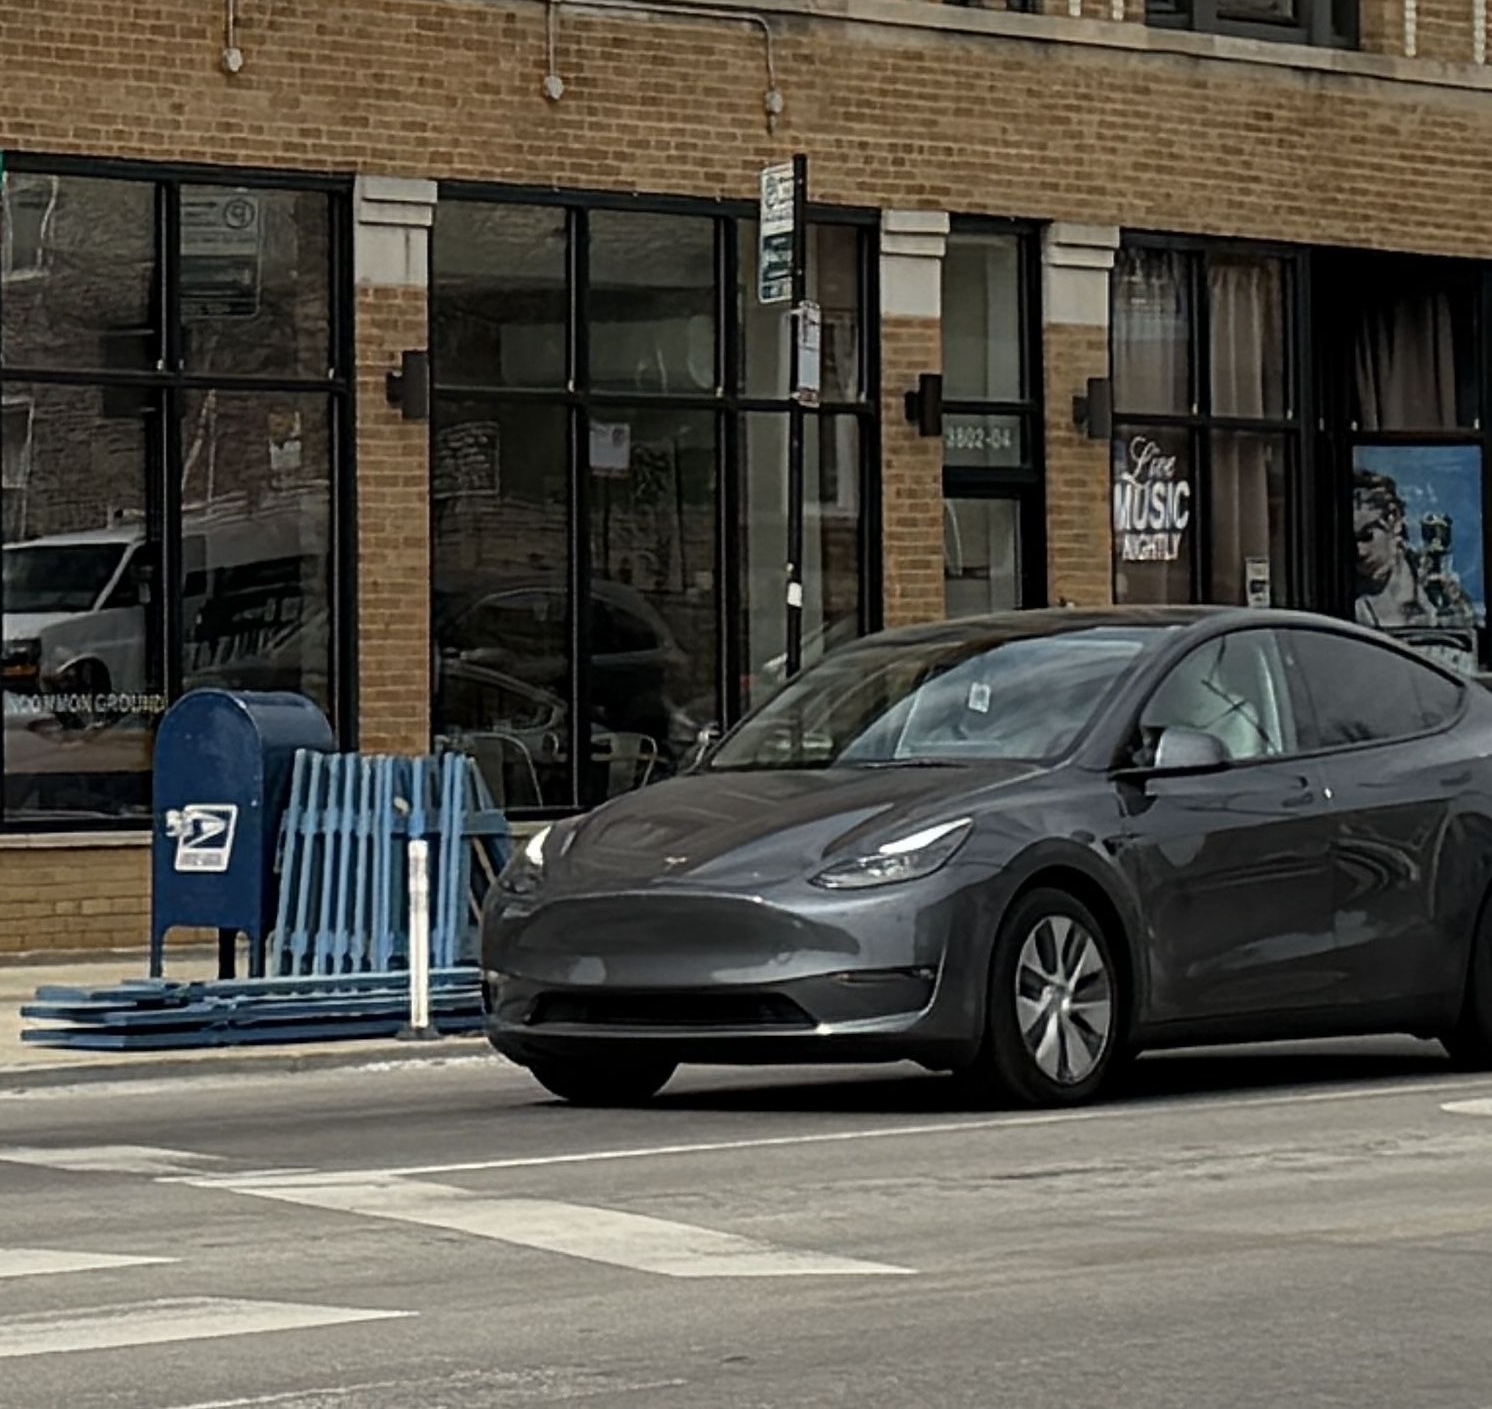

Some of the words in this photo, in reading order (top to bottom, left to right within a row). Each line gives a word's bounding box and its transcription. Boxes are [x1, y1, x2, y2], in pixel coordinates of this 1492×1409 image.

[1114, 480, 1191, 530] MUSIC
[1122, 533, 1182, 561] NIGHTLY
[95, 693, 165, 714] GROUND
